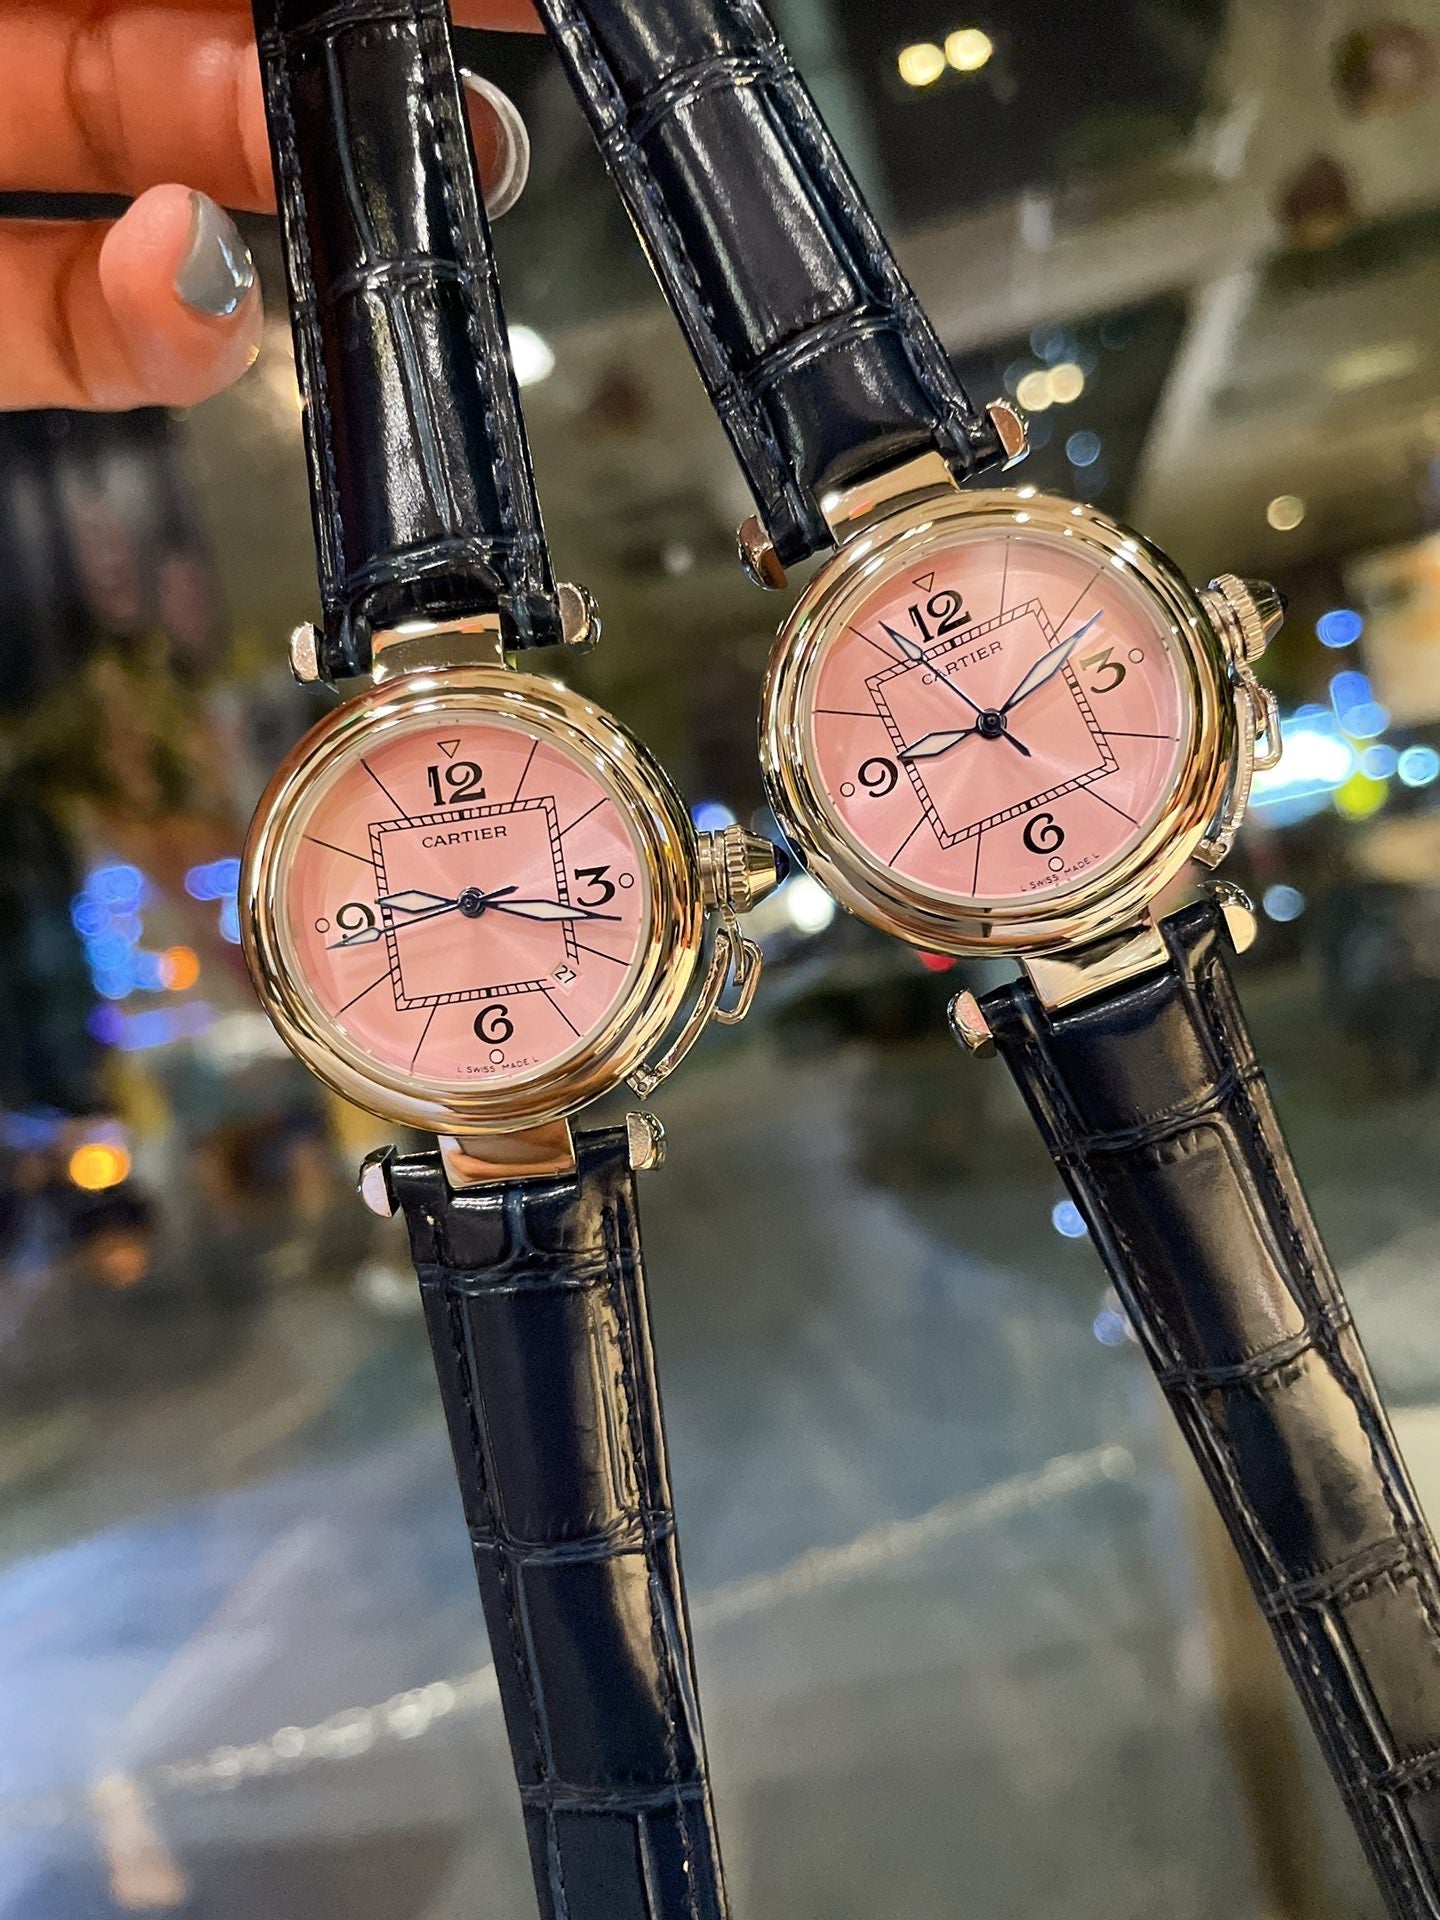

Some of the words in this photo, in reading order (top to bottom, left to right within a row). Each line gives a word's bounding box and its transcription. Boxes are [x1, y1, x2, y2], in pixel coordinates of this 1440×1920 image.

[908, 589, 972, 643] 12
[921, 640, 1004, 686] CARTIER
[1078, 646, 1127, 695] 3
[427, 761, 487, 806] 12
[858, 756, 899, 798] 9
[421, 825, 508, 848] CARTIER
[1023, 813, 1065, 854] 6
[574, 865, 616, 907] 3
[1029, 874, 1059, 889] SWISS
[1064, 857, 1091, 874] MADE
[336, 901, 376, 940] 9
[555, 965, 577, 984] 27
[474, 1004, 514, 1044] 6
[466, 1064, 496, 1074] SWISS
[502, 1058, 530, 1071] MADE
